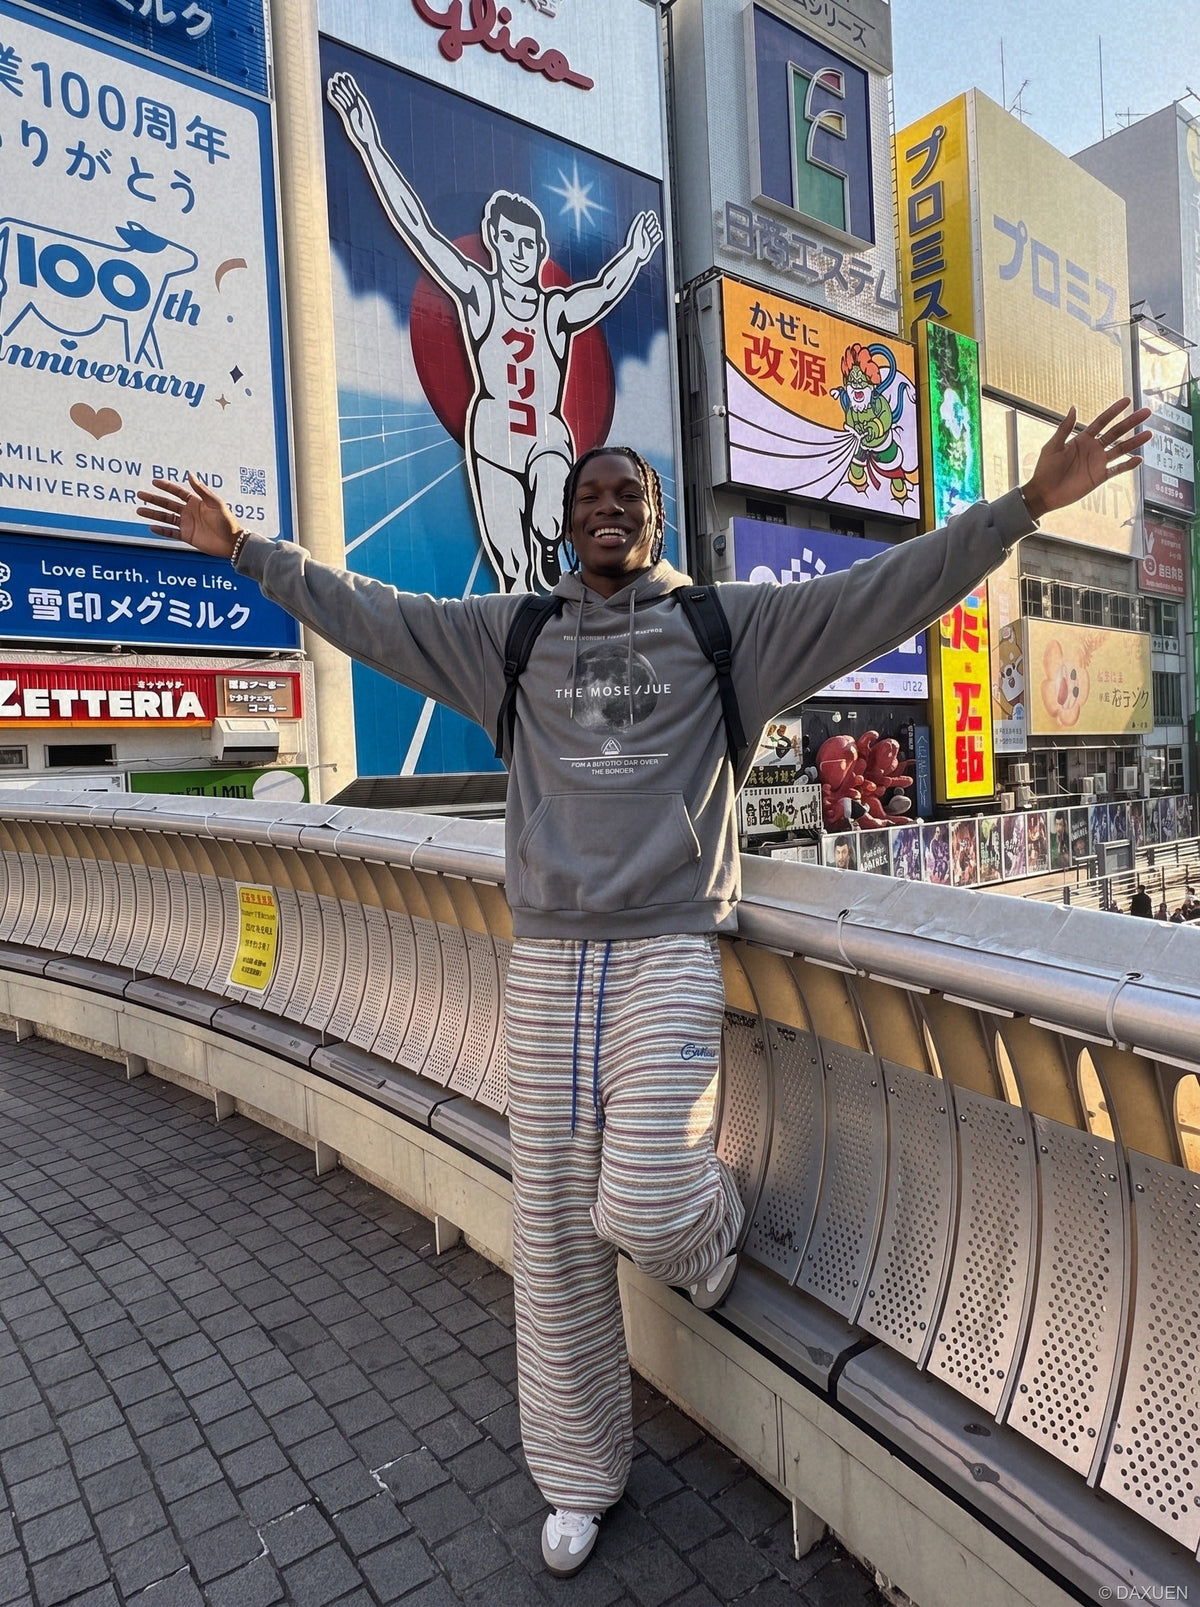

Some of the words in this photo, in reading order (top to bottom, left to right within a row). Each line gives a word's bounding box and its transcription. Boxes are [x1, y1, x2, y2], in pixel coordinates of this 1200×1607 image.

[116, 0, 212, 38] ルク
[0, 119, 195, 214] りがとう
[905, 125, 950, 318] プロミス
[16, 233, 151, 312] 100
[162, 289, 201, 327] th
[993, 214, 1122, 344] プロミス
[750, 301, 819, 348] かぜに
[0, 333, 206, 408] nniversary
[501, 326, 537, 437] グリコ
[742, 332, 828, 397] 改源
[0, 442, 63, 466] MILK
[75, 453, 142, 477] SNOW
[152, 465, 223, 488] BRAND
[41, 560, 86, 578] Love
[92, 565, 149, 583] Earth.
[158, 571, 197, 588] Love
[202, 574, 238, 591] Life.
[28, 587, 251, 630] 雪印メグミルク
[555, 688, 583, 699] THE
